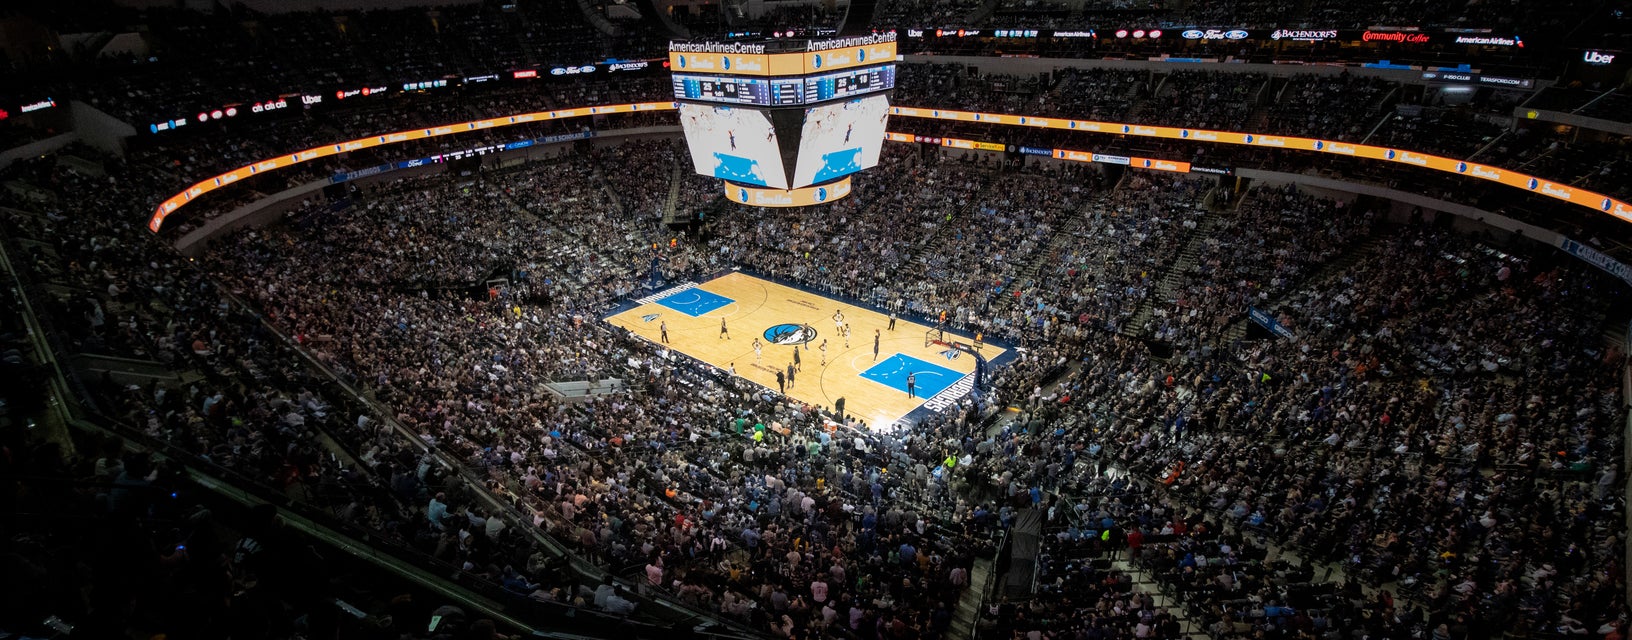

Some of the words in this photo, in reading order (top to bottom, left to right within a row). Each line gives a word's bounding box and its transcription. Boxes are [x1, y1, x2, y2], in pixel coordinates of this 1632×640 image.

[908, 29, 923, 37] Uber
[1203, 29, 1225, 39] Ford
[1281, 29, 1337, 38] BACHENDORF'S
[1362, 30, 1406, 42] Community
[1406, 33, 1430, 44] Coffee
[1584, 51, 1615, 64] Uber
[302, 95, 322, 105] Uber
